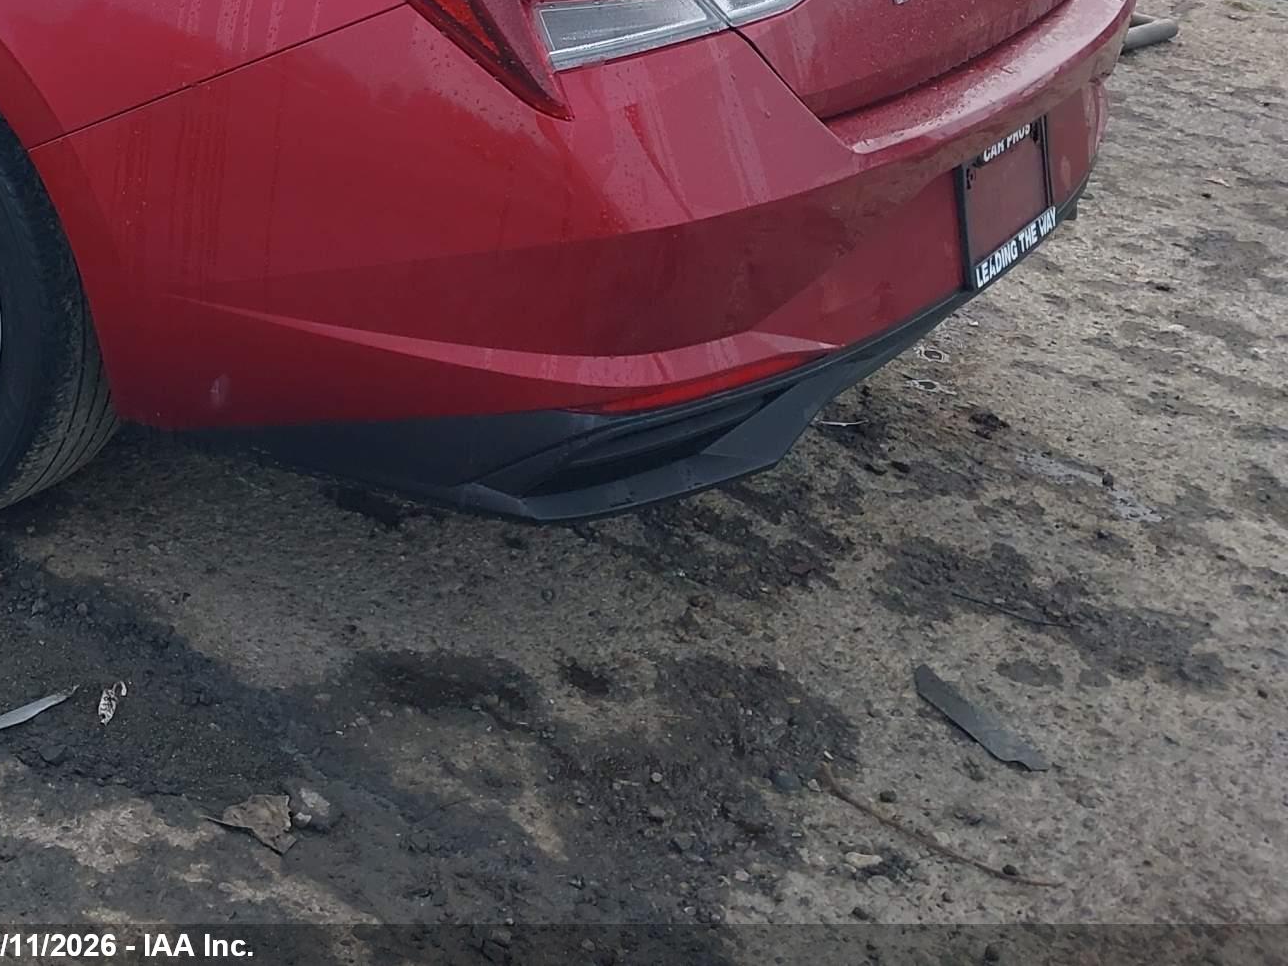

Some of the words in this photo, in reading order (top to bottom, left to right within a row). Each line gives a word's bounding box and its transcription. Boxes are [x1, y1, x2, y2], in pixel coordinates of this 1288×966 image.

[975, 240, 1019, 288] LEADING
[1018, 223, 1039, 253] THE
[1038, 206, 1057, 237] WAY
